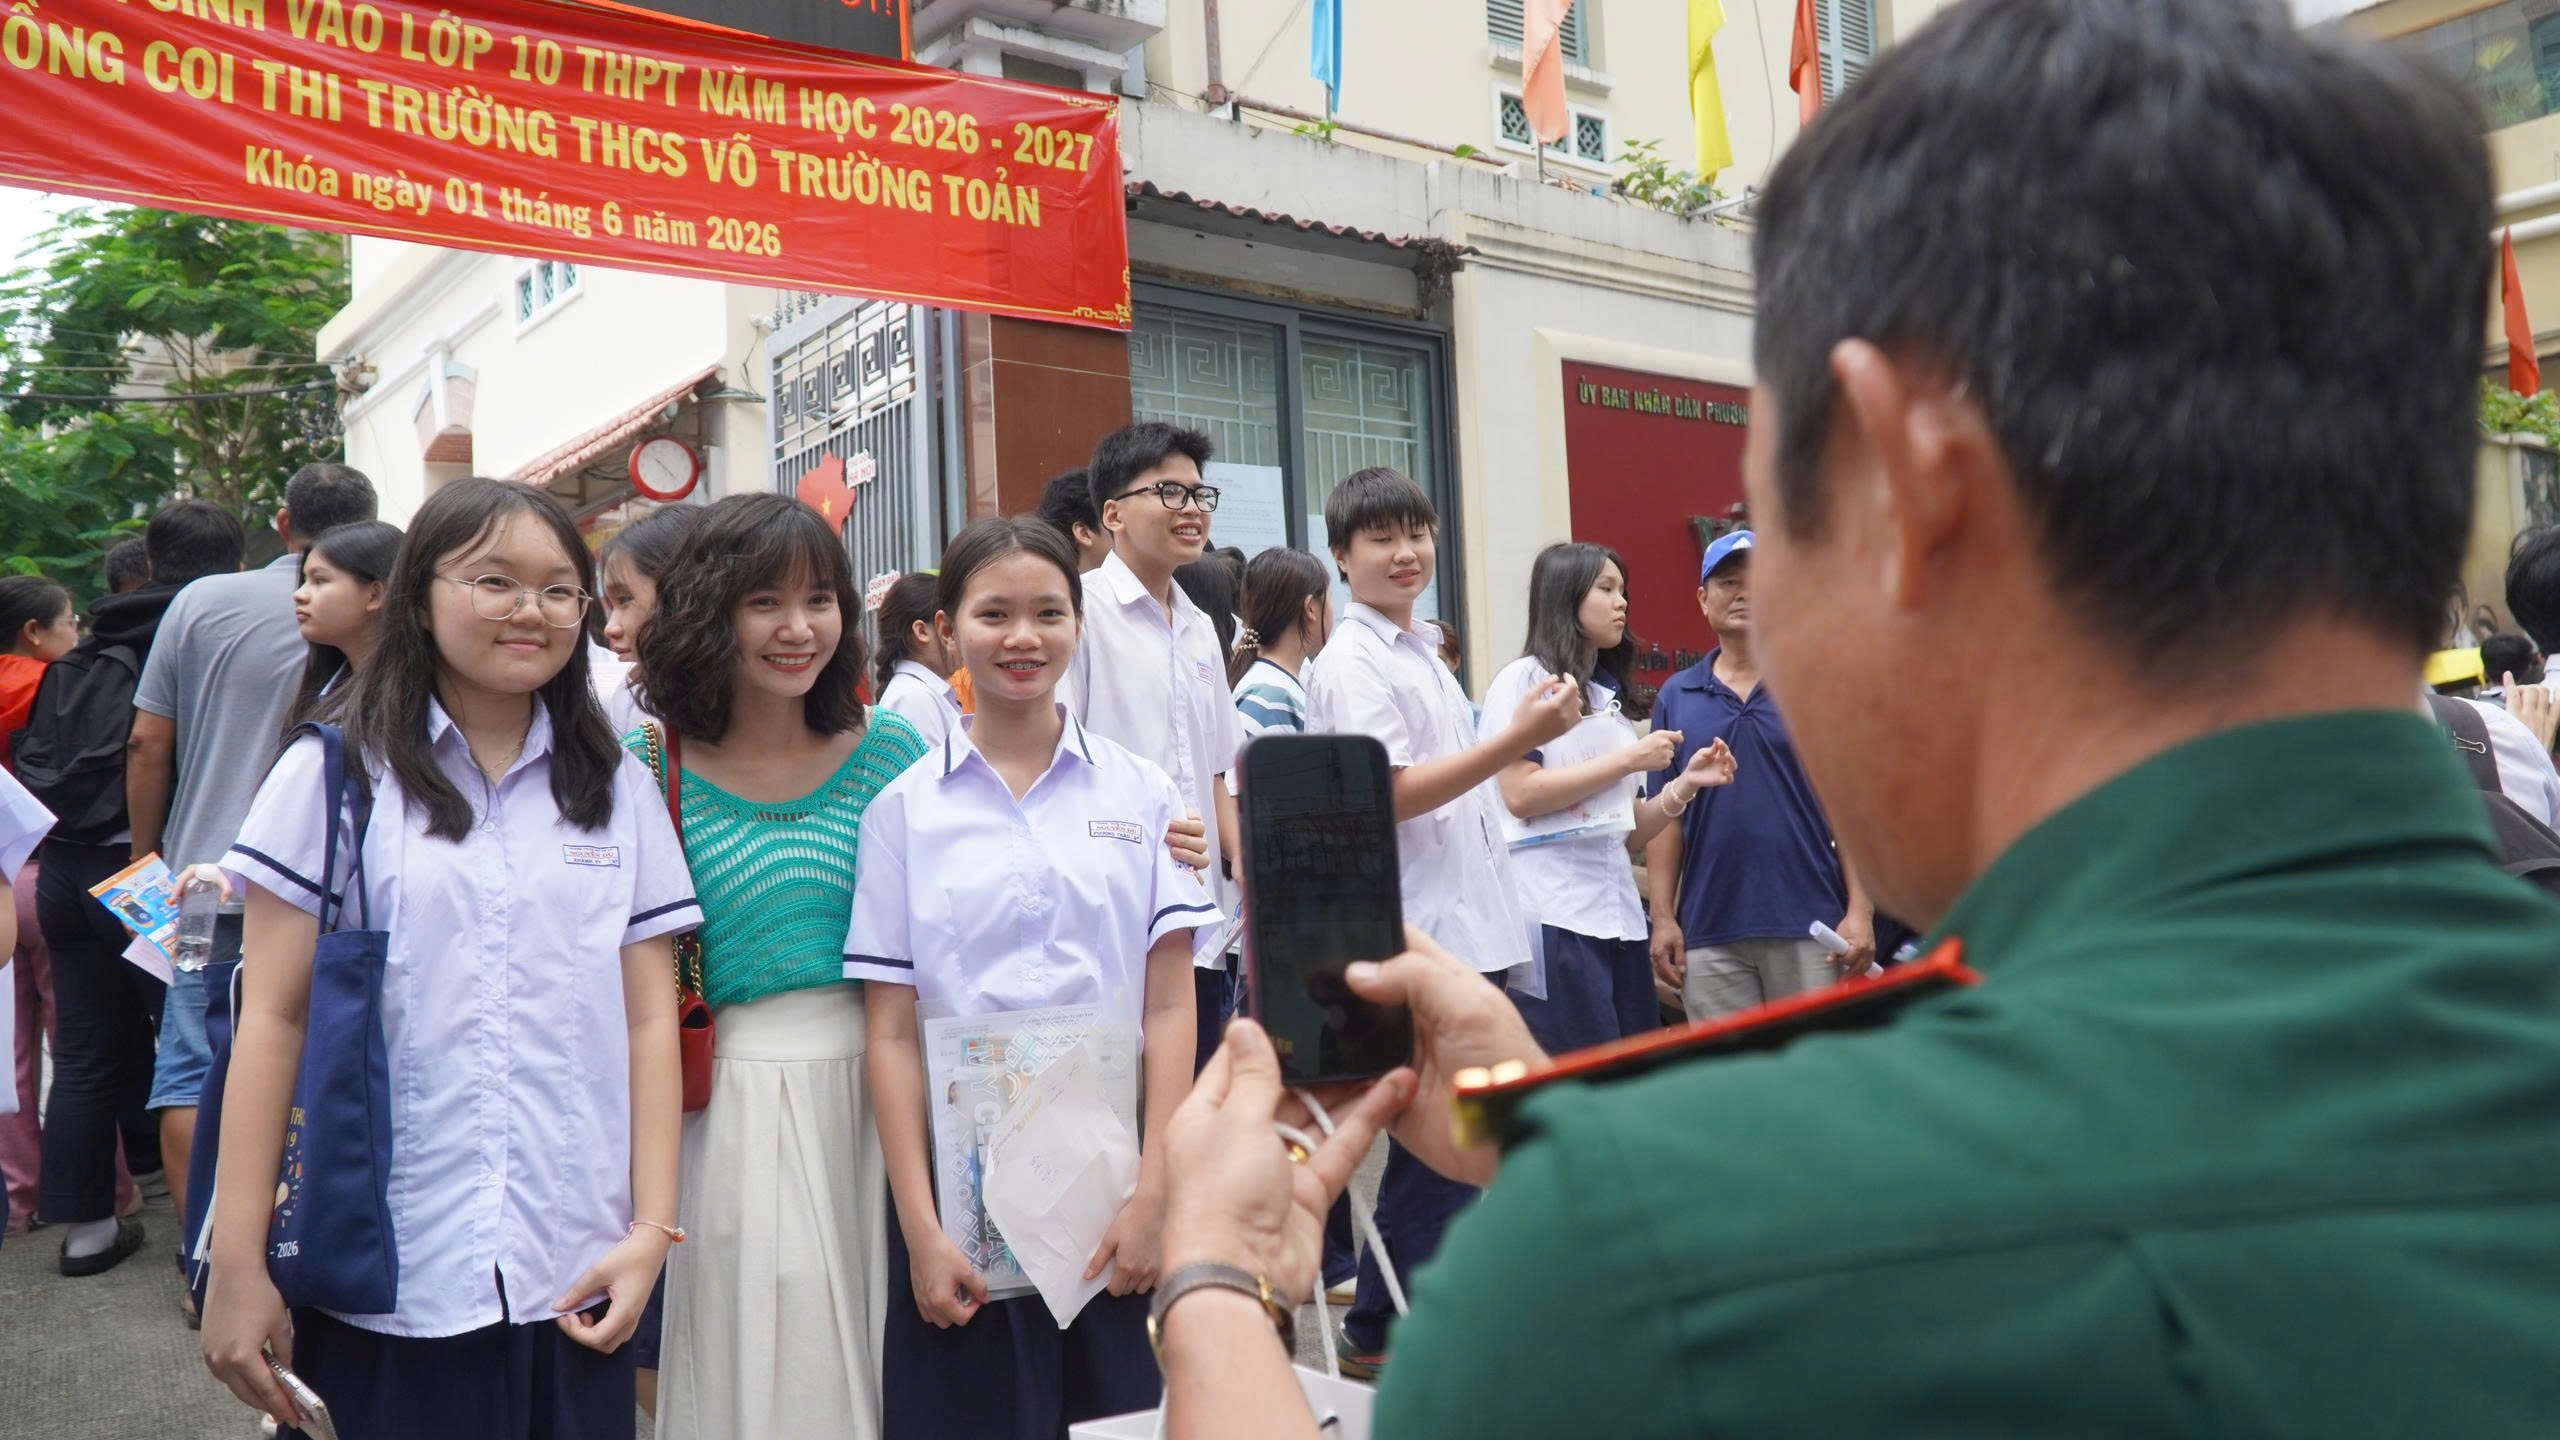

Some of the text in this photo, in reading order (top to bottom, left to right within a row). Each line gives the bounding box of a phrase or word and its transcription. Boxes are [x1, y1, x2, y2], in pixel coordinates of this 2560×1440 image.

[143, 40, 234, 104] COI
[252, 58, 342, 122] THI
[357, 79, 558, 159] TRƯỜNG
[570, 115, 688, 177] THCS
[700, 132, 758, 188] VÕ
[771, 149, 932, 214] TRƯỜNG
[942, 166, 1041, 228] TOẢN
[400, 9, 494, 71] LỚP
[509, 34, 562, 86] 10
[576, 45, 685, 107] THPT
[699, 65, 786, 125] NĂM
[799, 87, 878, 143] HỌC
[889, 103, 980, 154] 2026
[1013, 122, 1094, 172] 2027
[245, 144, 781, 257] Khóa ngày 01 tháng 6 năm 2026
[1601, 386, 1629, 409] BAN
[1634, 388, 1671, 416] NHÂN
[1706, 400, 1750, 426] PHƯỜN
[277, 1240, 299, 1258] 2026
